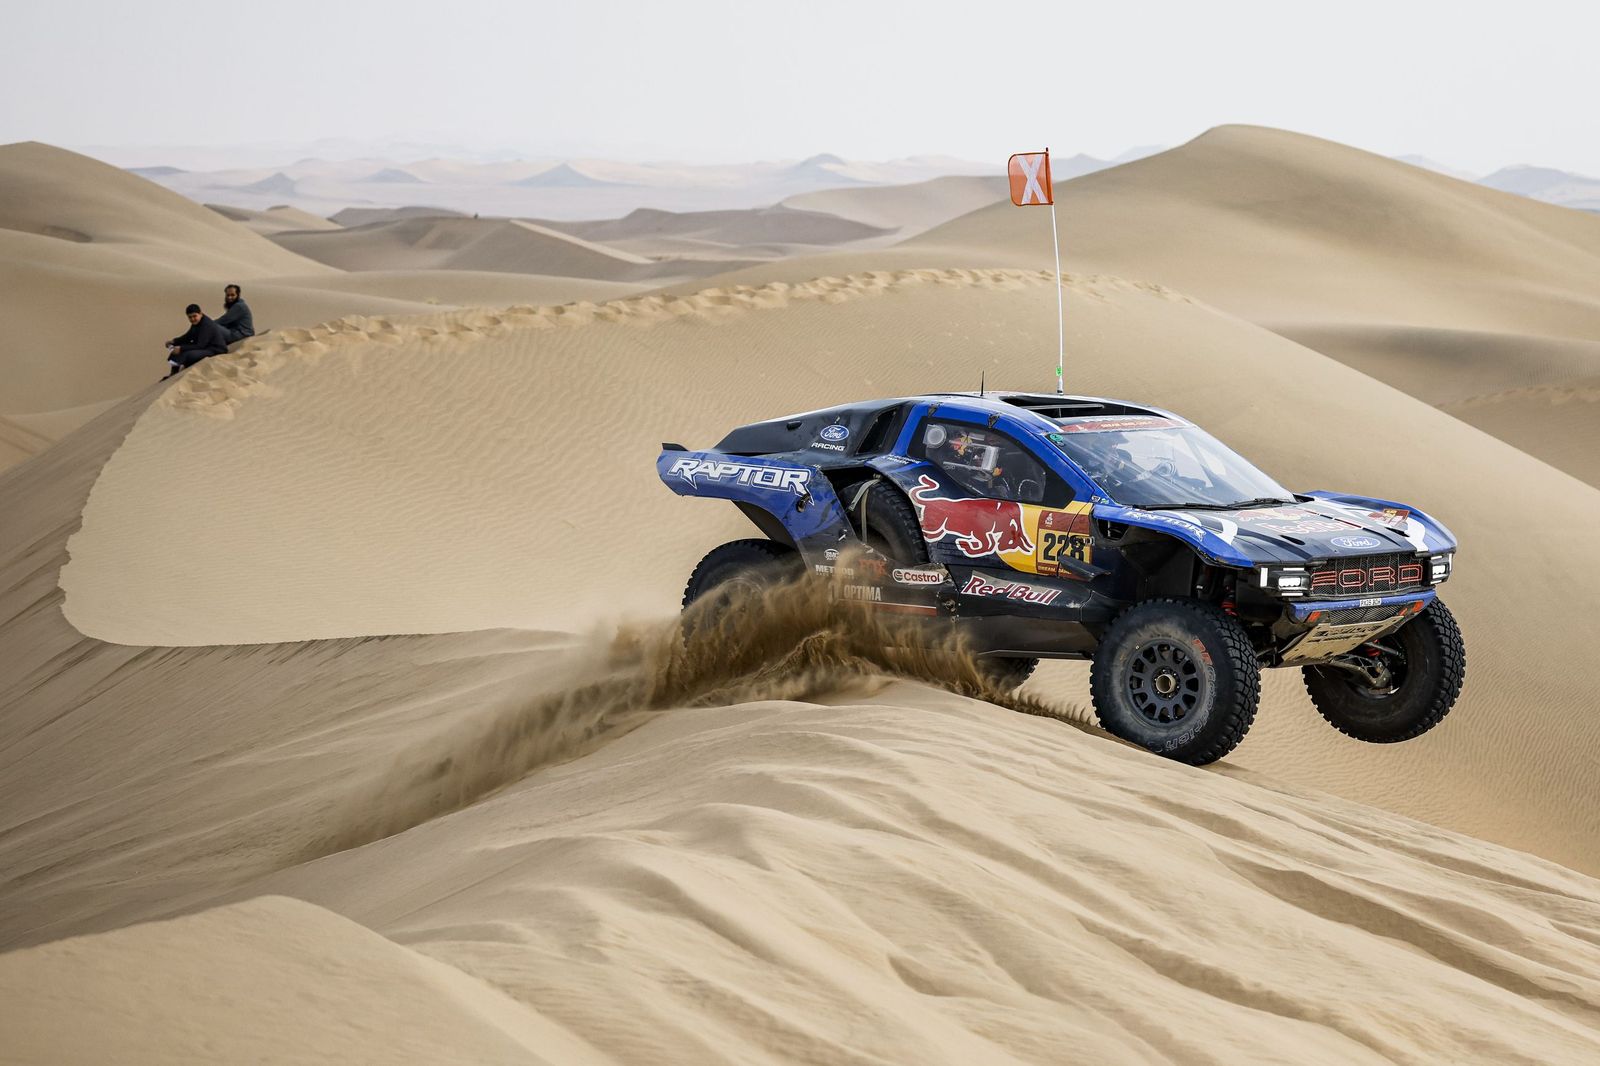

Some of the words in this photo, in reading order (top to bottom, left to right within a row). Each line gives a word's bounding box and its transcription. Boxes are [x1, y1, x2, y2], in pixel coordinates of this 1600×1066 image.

[811, 442, 846, 451] RACING
[668, 458, 815, 505] RAPTOR
[1043, 533, 1085, 562] 228
[815, 564, 854, 576] METOD
[903, 571, 941, 583] Castrol
[1311, 564, 1422, 588] FORD
[843, 584, 882, 601] OPTIMA
[961, 575, 1014, 597] Red
[1006, 583, 1062, 605] Bull
